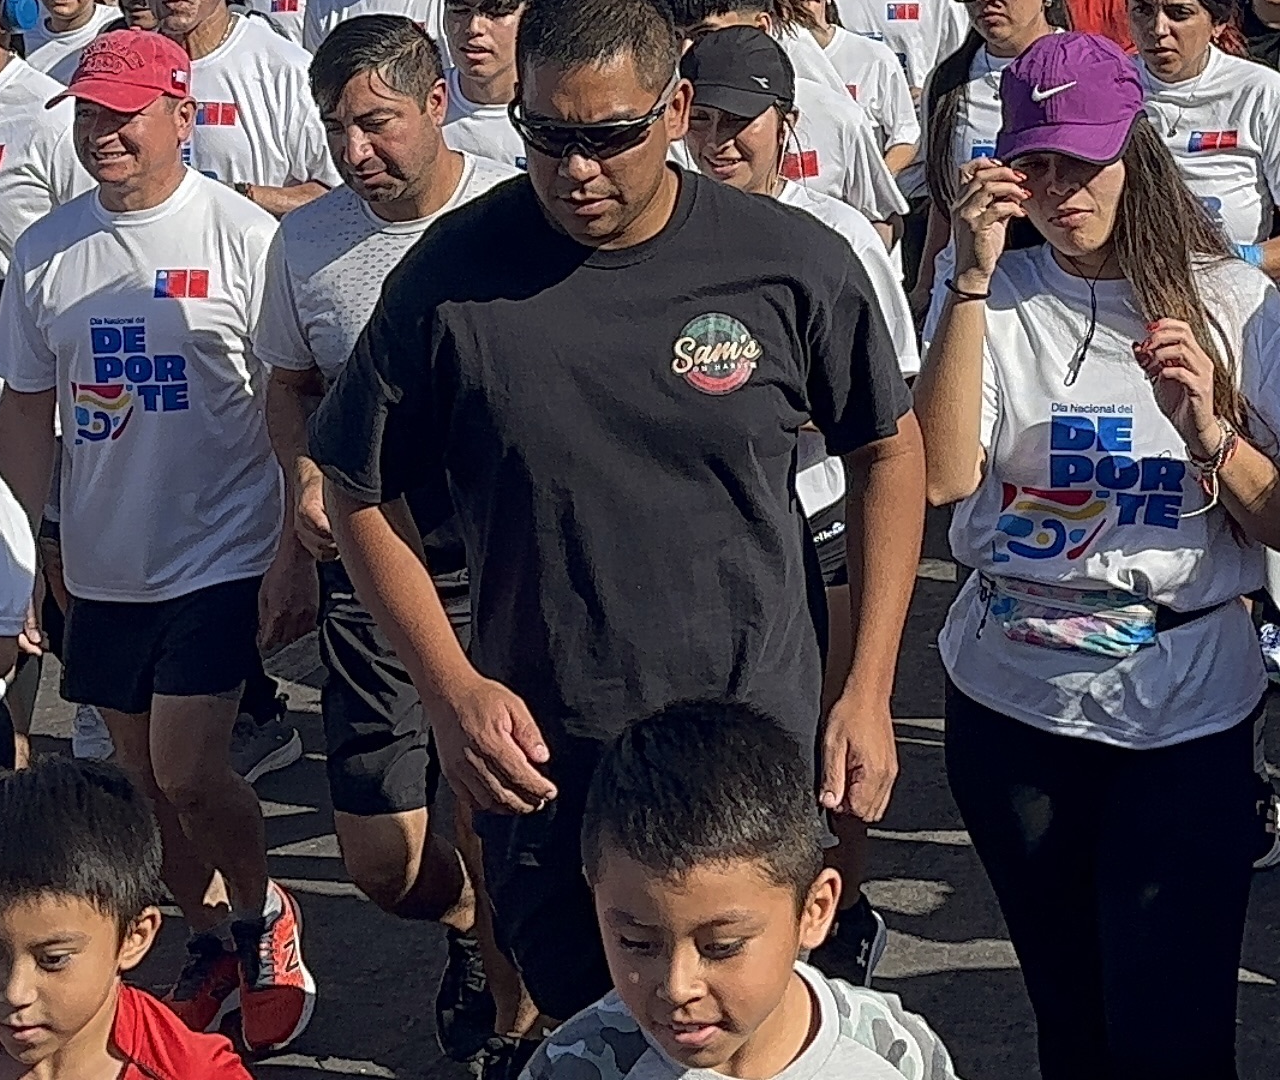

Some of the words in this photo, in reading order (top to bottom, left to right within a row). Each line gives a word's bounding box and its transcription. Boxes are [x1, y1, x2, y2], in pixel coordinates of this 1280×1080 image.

[90, 326, 146, 354] DE
[672, 333, 761, 374] Sam's
[94, 355, 188, 383] POR
[137, 383, 189, 411] TE
[1050, 415, 1133, 452] DE
[1050, 454, 1186, 492] POR
[1116, 492, 1182, 530] TE
